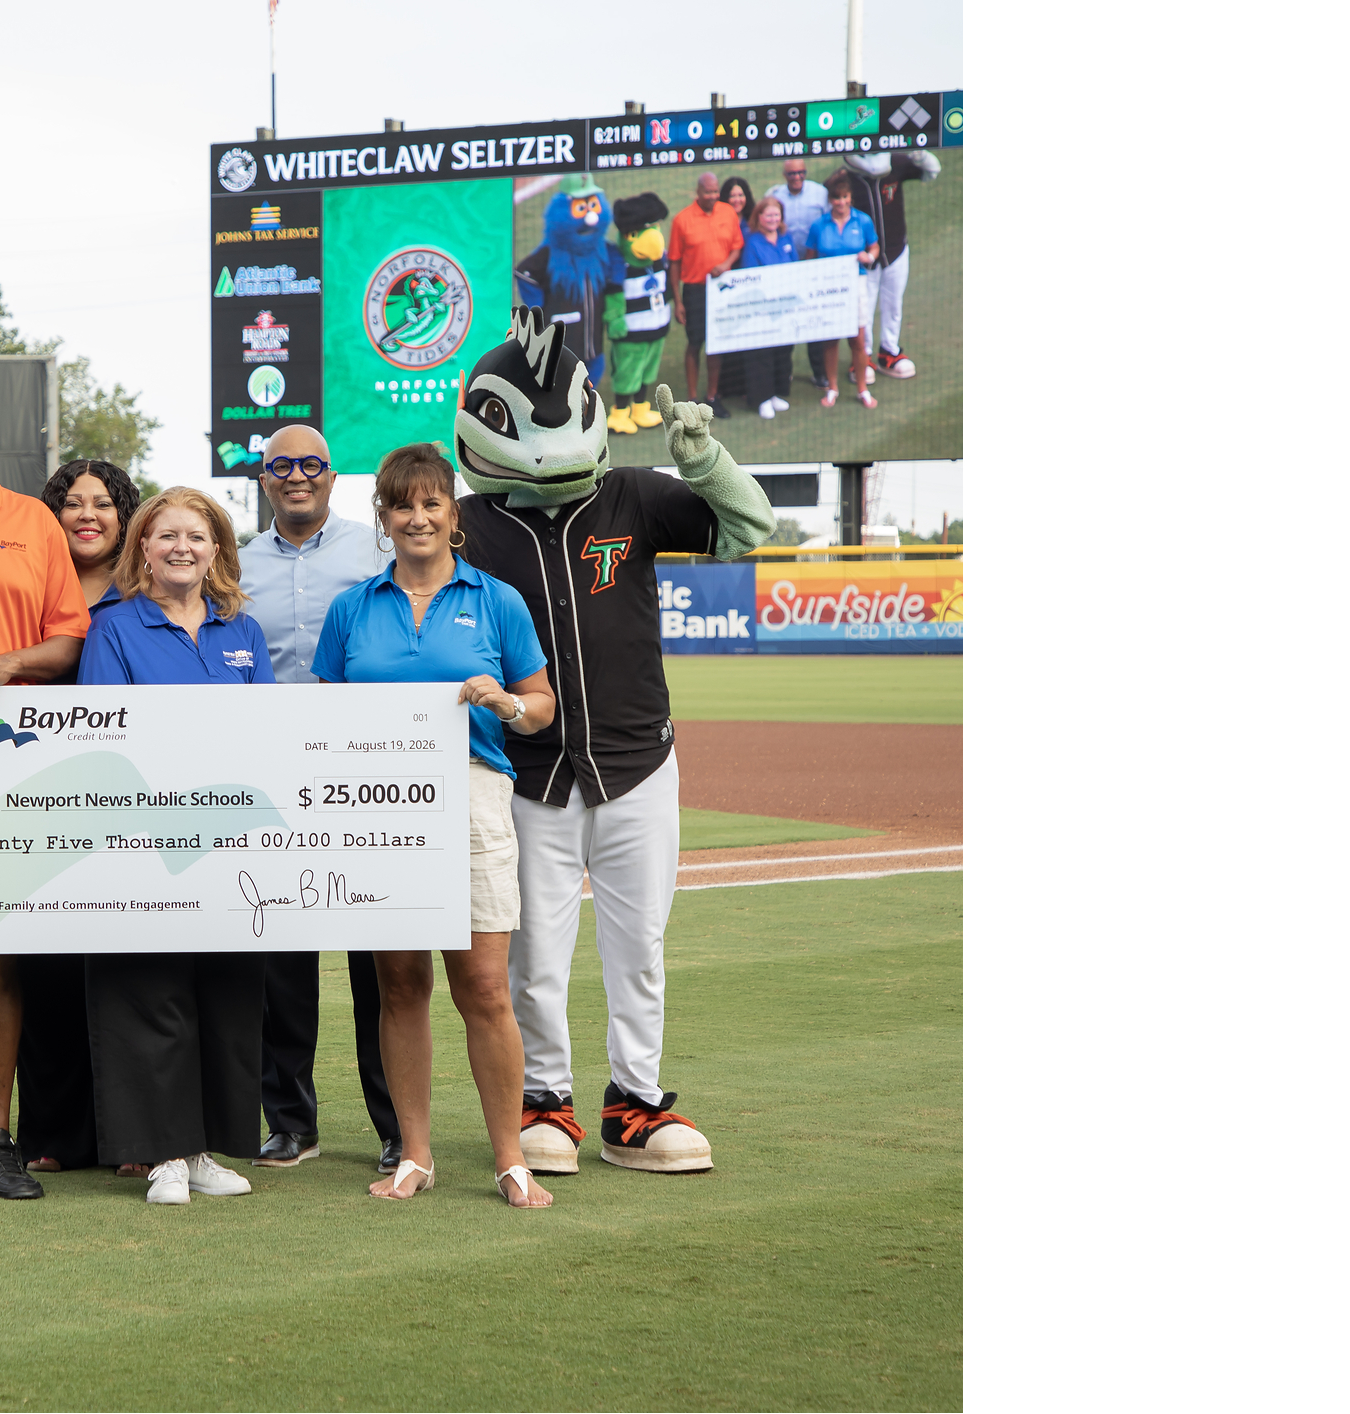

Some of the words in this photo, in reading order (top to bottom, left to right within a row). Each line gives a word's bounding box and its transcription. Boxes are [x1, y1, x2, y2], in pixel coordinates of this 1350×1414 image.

[747, 110, 756, 122] B
[767, 108, 777, 120] S
[818, 112, 834, 130] 0
[594, 126, 620, 144] 6:21
[622, 124, 640, 143] PM
[650, 118, 671, 145] N
[688, 120, 702, 140] 0
[730, 119, 739, 138] 1
[745, 124, 758, 140] 0
[765, 122, 778, 139] 0
[787, 121, 800, 137] 0
[812, 140, 822, 154] 5
[860, 136, 872, 151] 0
[916, 133, 928, 147] 0
[263, 143, 445, 182] WHITECLAW
[451, 134, 576, 170] SELTZER
[633, 152, 643, 166] 5
[684, 148, 695, 162] 0
[738, 146, 748, 160] 2
[215, 230, 252, 245] JOHNS
[255, 230, 275, 241] TAX
[275, 227, 320, 240] SERVICE
[234, 264, 297, 282] Atlantic
[372, 254, 452, 303] NORFOLK
[234, 280, 280, 296] Union
[280, 276, 321, 295] Bank
[406, 332, 458, 362] TIDES
[375, 378, 459, 391] NORFOLK
[391, 392, 444, 403] TIDES
[222, 406, 276, 420] DOLLAR
[277, 404, 312, 418] TREE
[1, 540, 26, 549] BayPort
[581, 536, 632, 594] T
[760, 580, 926, 632] Surfside
[661, 608, 750, 639] Bank
[845, 624, 879, 639] ICED
[885, 623, 916, 638] TEA
[18, 707, 128, 734] BayPort
[413, 714, 428, 722] 001
[67, 732, 95, 741] Credit
[98, 733, 126, 741] Union
[347, 740, 387, 753] August
[390, 741, 406, 751] 19,
[409, 740, 435, 750] 2026
[6, 793, 81, 811] Newport
[86, 793, 132, 807] News
[137, 792, 186, 806] Public
[190, 791, 254, 806] Schools
[298, 786, 312, 810] $
[323, 784, 435, 807] 25,000.00
[47, 836, 94, 850] Five
[106, 834, 201, 849] Thousand
[213, 834, 249, 848] and
[261, 832, 330, 850] 00/100
[343, 833, 426, 847] Dollars
[0, 901, 35, 912] Family
[38, 901, 58, 910] and
[62, 900, 126, 912] Community
[130, 900, 200, 912] Engagement
[238, 870, 297, 937] James
[300, 869, 319, 908] B
